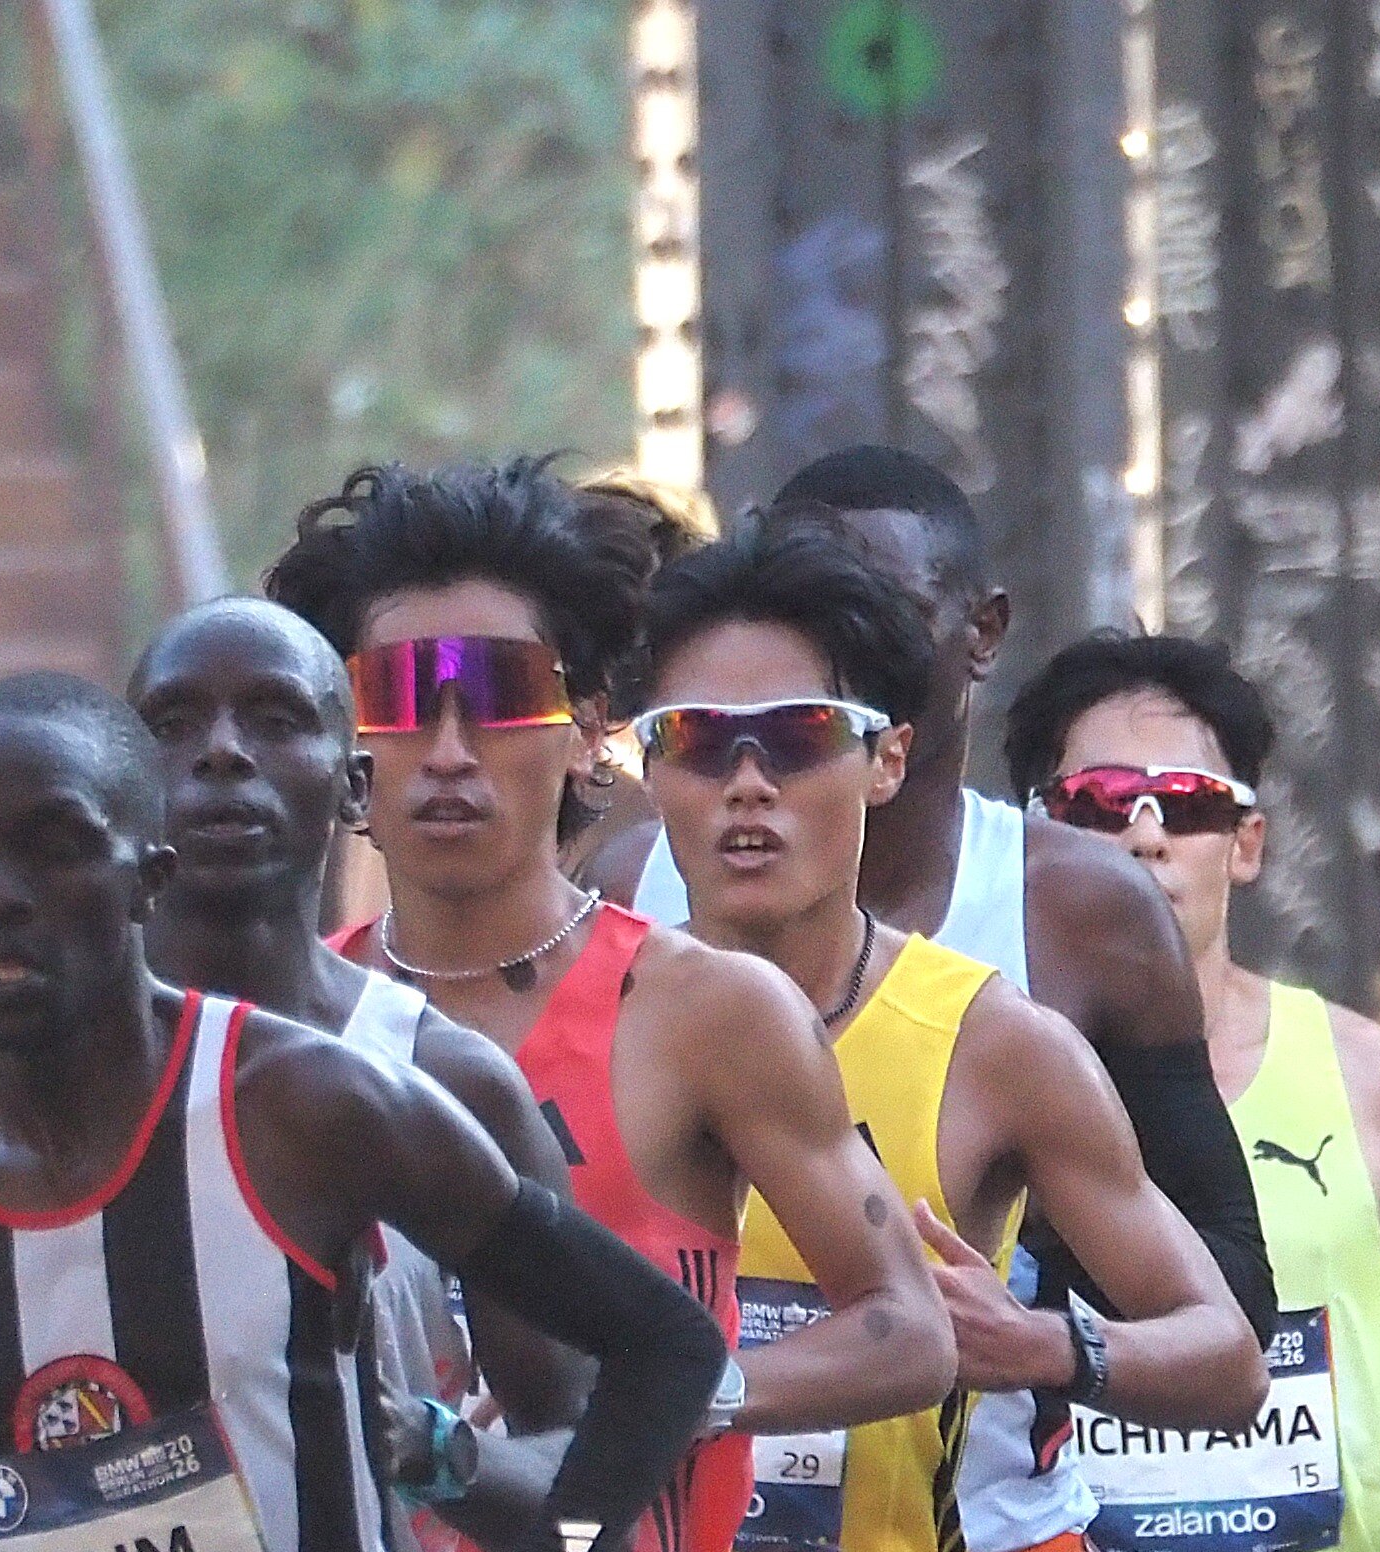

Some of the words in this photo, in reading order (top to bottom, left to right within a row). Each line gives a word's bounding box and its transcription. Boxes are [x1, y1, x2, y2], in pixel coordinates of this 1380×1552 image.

[741, 1302, 781, 1320] BMW
[1281, 1331, 1304, 1349] 20
[1282, 1348, 1306, 1366] 26
[164, 1434, 194, 1460] 20
[172, 1453, 202, 1479] 26
[780, 1452, 820, 1479] 29
[1288, 1463, 1321, 1488] 15
[1133, 1503, 1277, 1538] zalando
